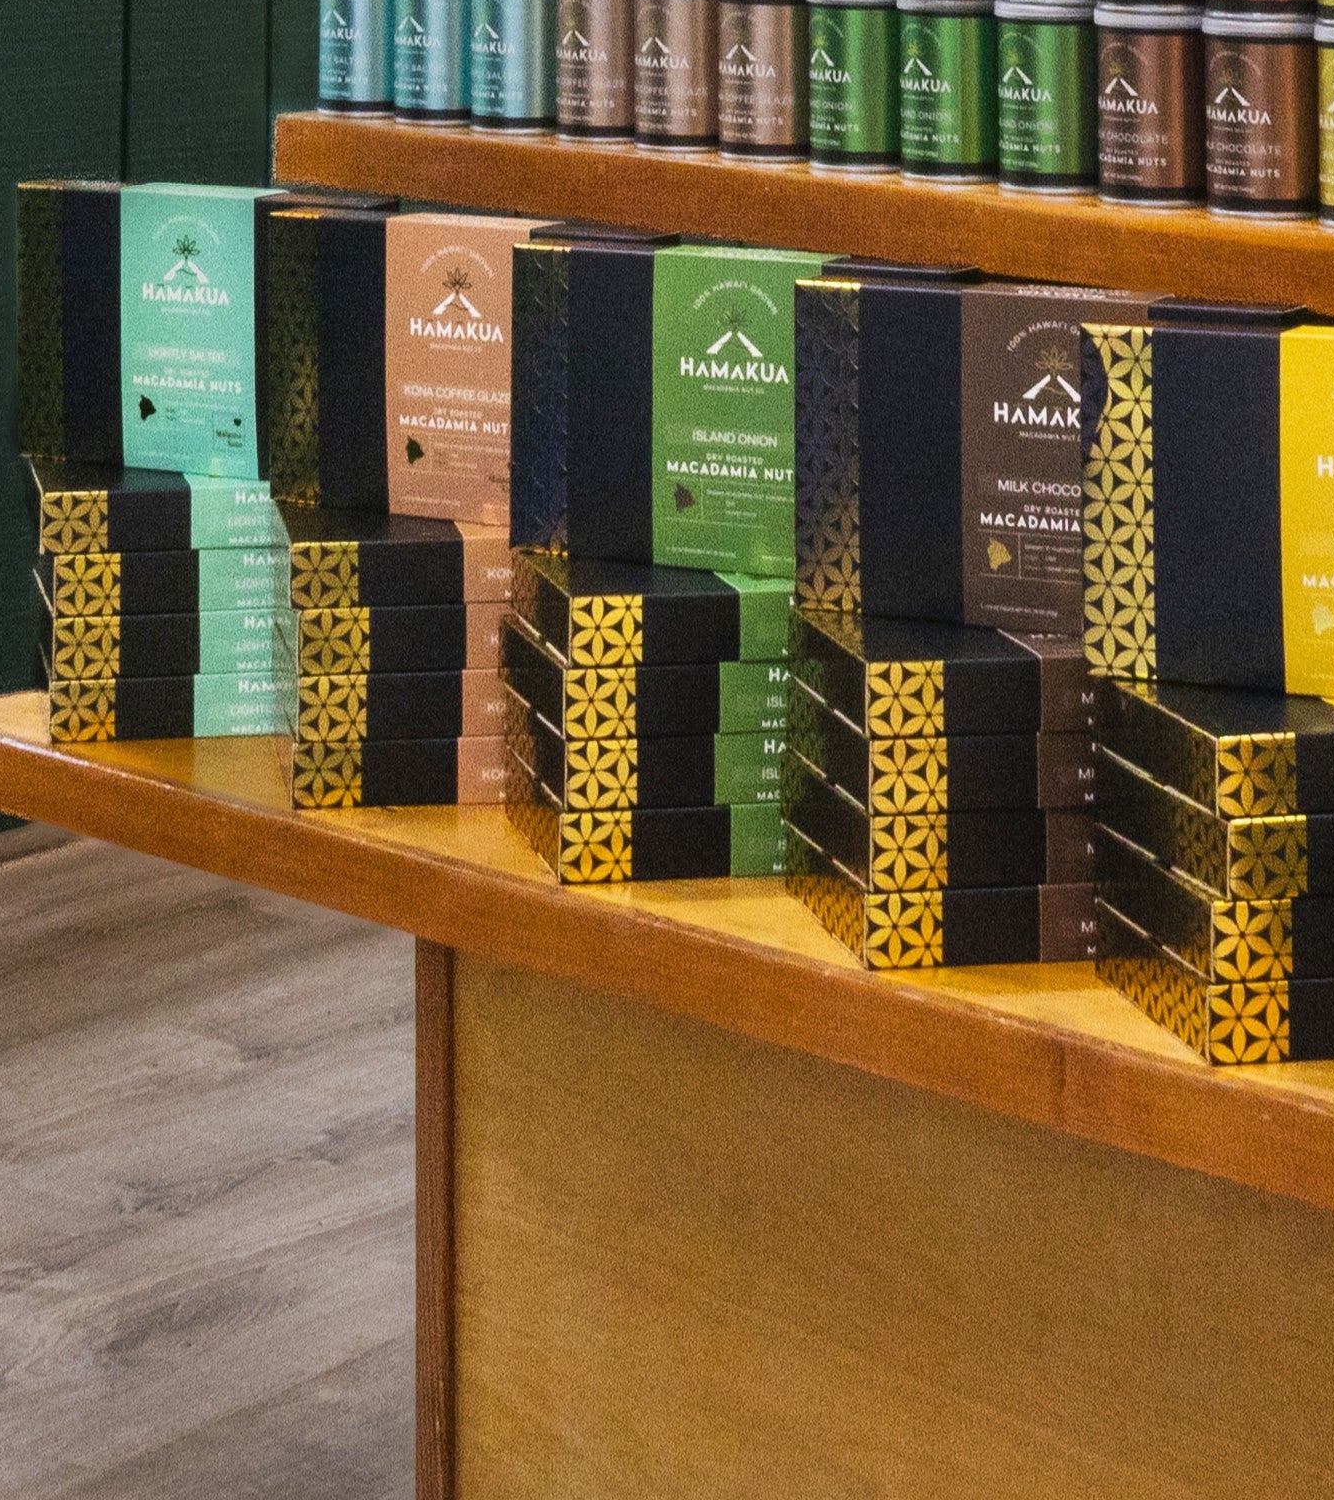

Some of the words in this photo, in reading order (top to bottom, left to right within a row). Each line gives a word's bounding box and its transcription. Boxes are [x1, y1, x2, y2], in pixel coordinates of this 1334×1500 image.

[1250, 169, 1280, 178] NUTS
[133, 375, 206, 391] MACADAMIA
[211, 381, 242, 393] NUTS
[436, 388, 475, 400] COFFEE
[399, 415, 477, 432] MACADAMIA
[692, 430, 736, 444] ISLAND
[738, 434, 777, 448] ONION
[667, 460, 757, 479] MACADAMIA
[997, 480, 1028, 493] MILK
[980, 512, 1081, 532] MACADAMIA
